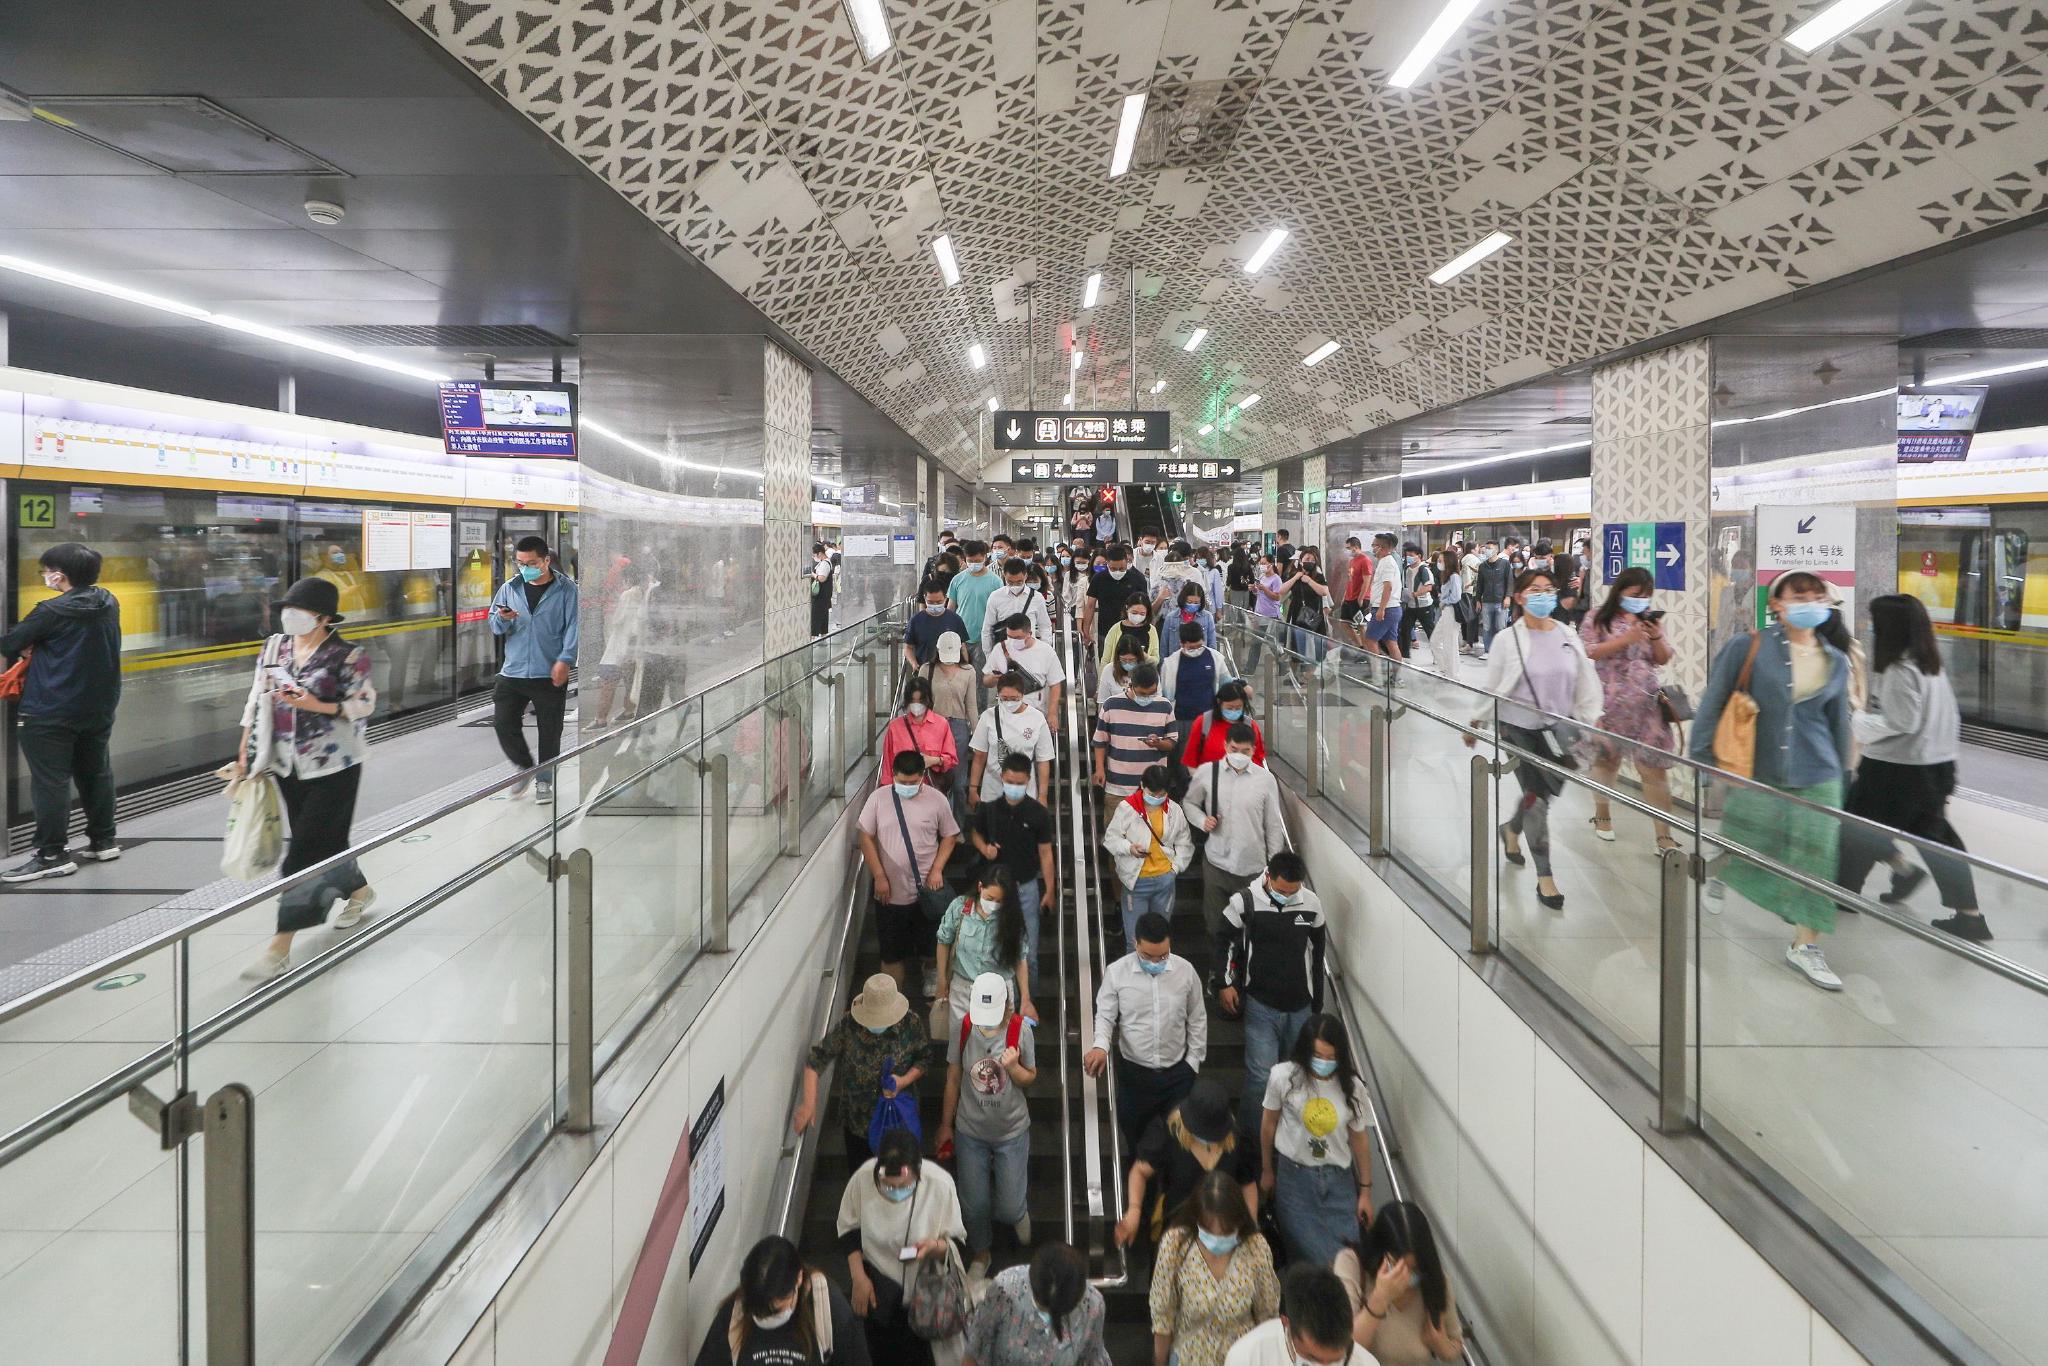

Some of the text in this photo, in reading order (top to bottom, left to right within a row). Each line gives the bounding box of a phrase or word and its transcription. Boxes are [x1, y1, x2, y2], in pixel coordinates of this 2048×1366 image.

[1112, 418, 1146, 434] 换乘
[1054, 463, 1096, 473] 开金安桥
[24, 498, 50, 522] 12
[1611, 534, 1621, 550] A
[1632, 537, 1651, 564] 出
[1769, 544, 1844, 557] 换乘 14 号线
[1612, 559, 1622, 576] D
